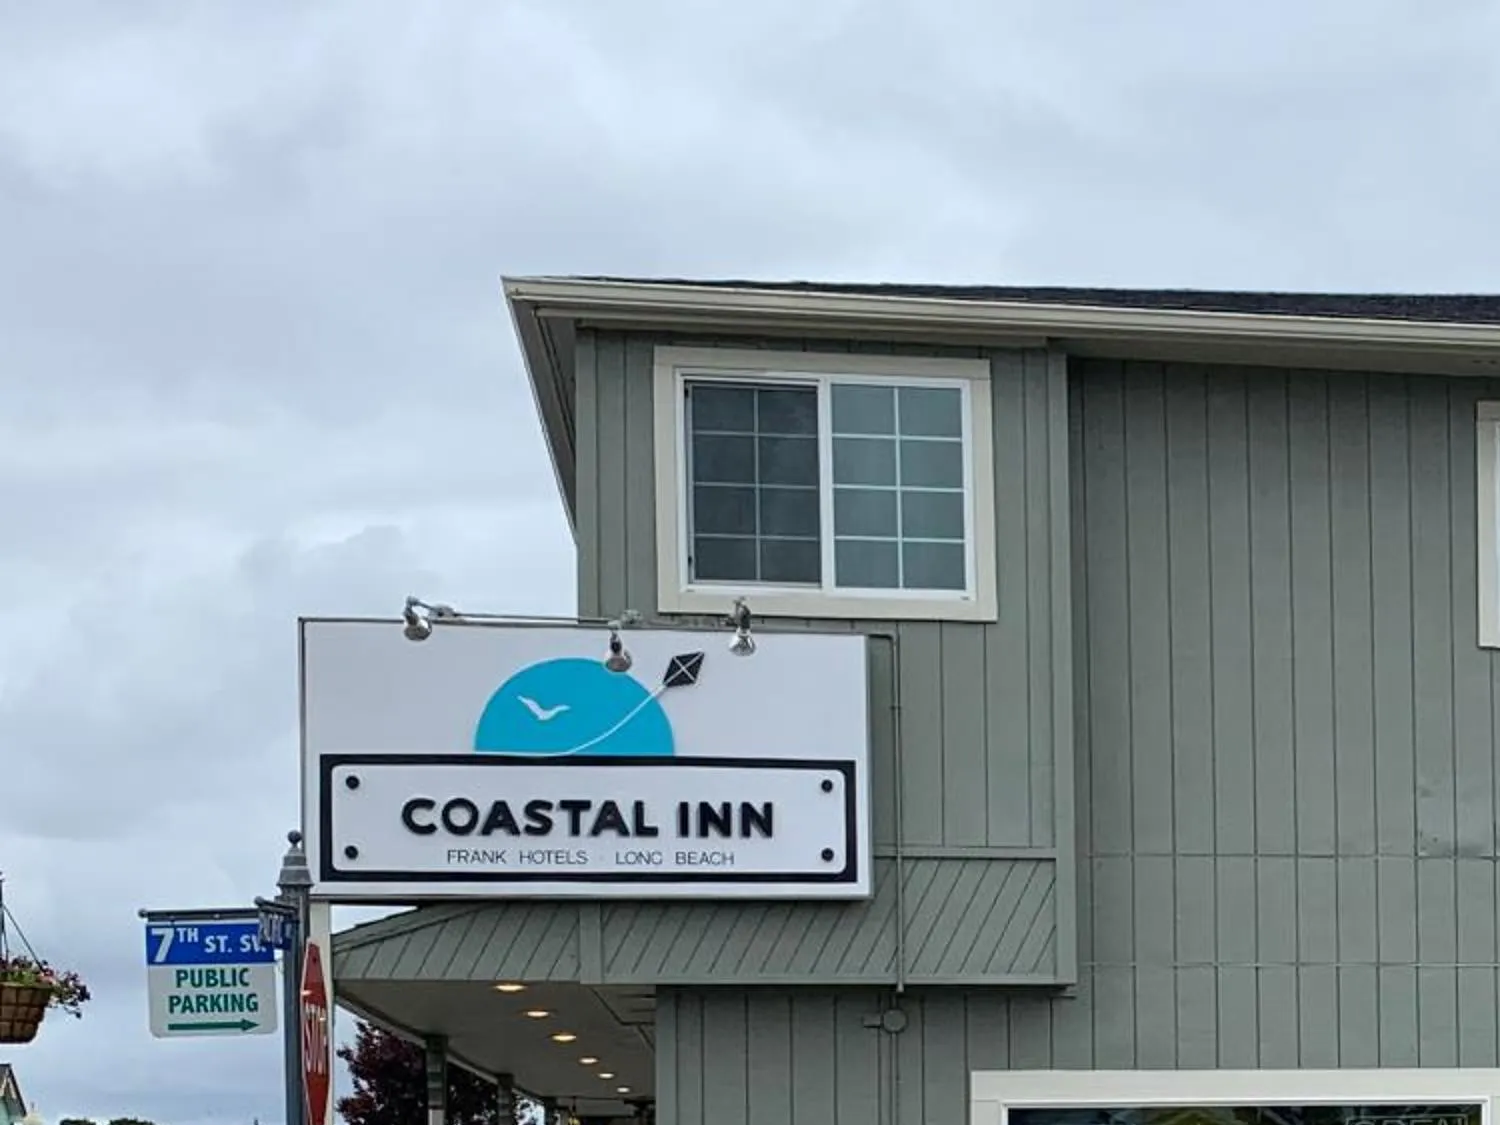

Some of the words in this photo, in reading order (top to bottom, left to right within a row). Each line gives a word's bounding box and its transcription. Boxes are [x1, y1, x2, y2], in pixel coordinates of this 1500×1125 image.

[401, 798, 659, 838] COASTAL
[675, 800, 774, 839] INN
[446, 849, 507, 866] FRANK
[519, 849, 589, 867] HOTELS
[615, 850, 663, 867] LONG
[675, 850, 735, 867] BEACH
[151, 926, 200, 964] 7TH
[203, 934, 233, 954] ST.
[175, 967, 251, 989] PUBLIC
[167, 993, 260, 1015] PARKING
